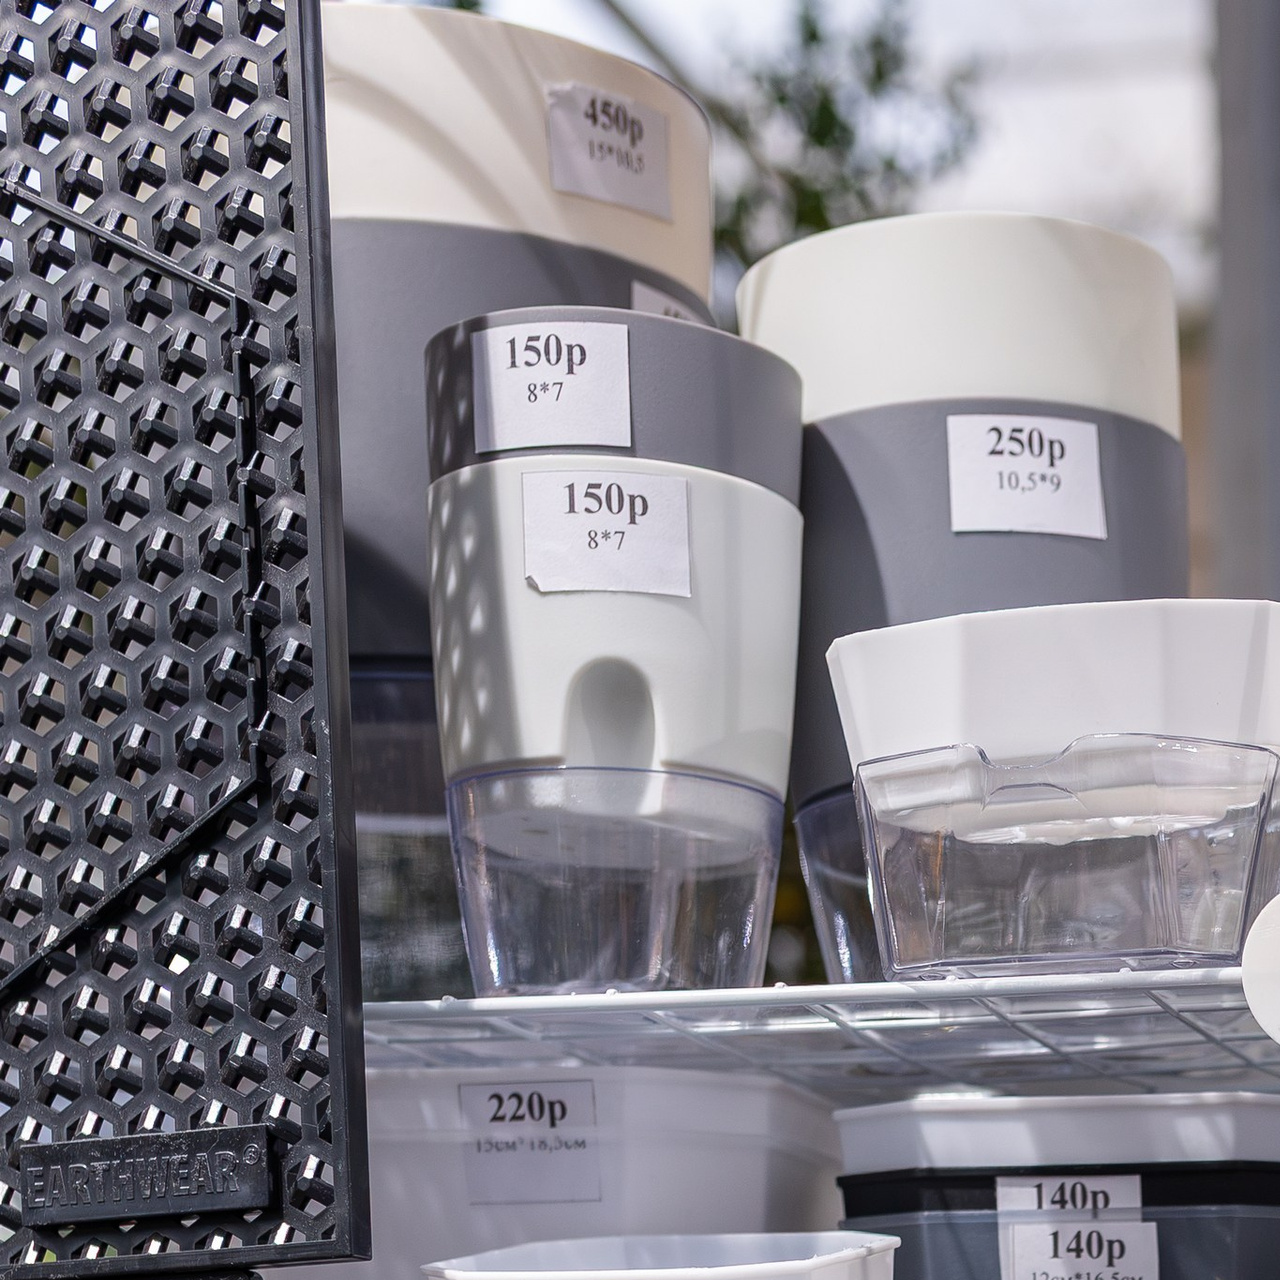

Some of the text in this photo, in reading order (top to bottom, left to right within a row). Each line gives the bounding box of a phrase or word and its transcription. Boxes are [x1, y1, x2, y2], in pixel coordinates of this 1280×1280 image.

[506, 333, 587, 375] 150р
[986, 427, 1066, 465] 250р
[564, 482, 649, 525] 150р
[487, 1090, 567, 1129] 220р
[1033, 1181, 1110, 1218] 140р
[1049, 1230, 1126, 1268] 140р
